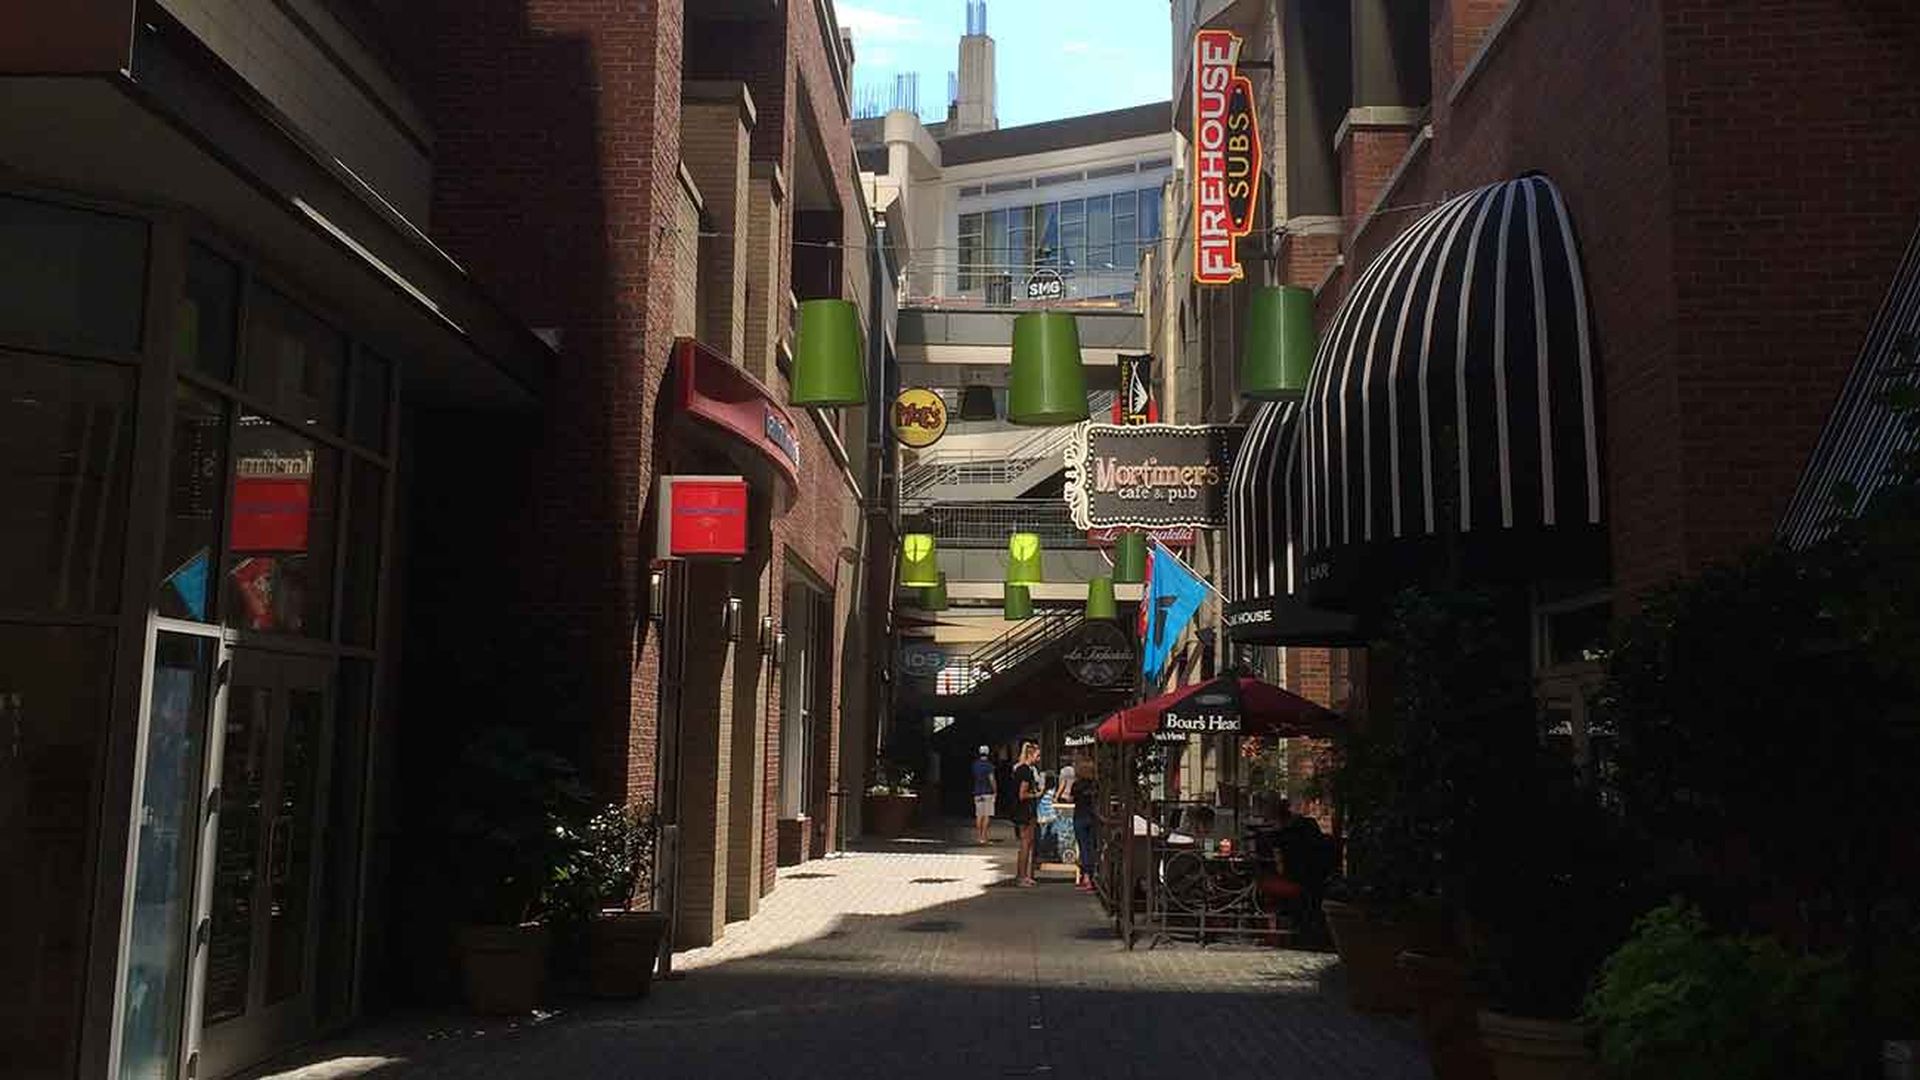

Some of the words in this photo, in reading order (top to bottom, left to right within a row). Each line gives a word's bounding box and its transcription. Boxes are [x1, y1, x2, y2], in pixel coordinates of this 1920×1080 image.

[1201, 40, 1241, 275] FIREHOUSE
[1228, 112, 1250, 199] SUBS
[1095, 456, 1219, 493] Mortimer's
[1168, 483, 1198, 504] pub
[1166, 712, 1207, 730] Boar's
